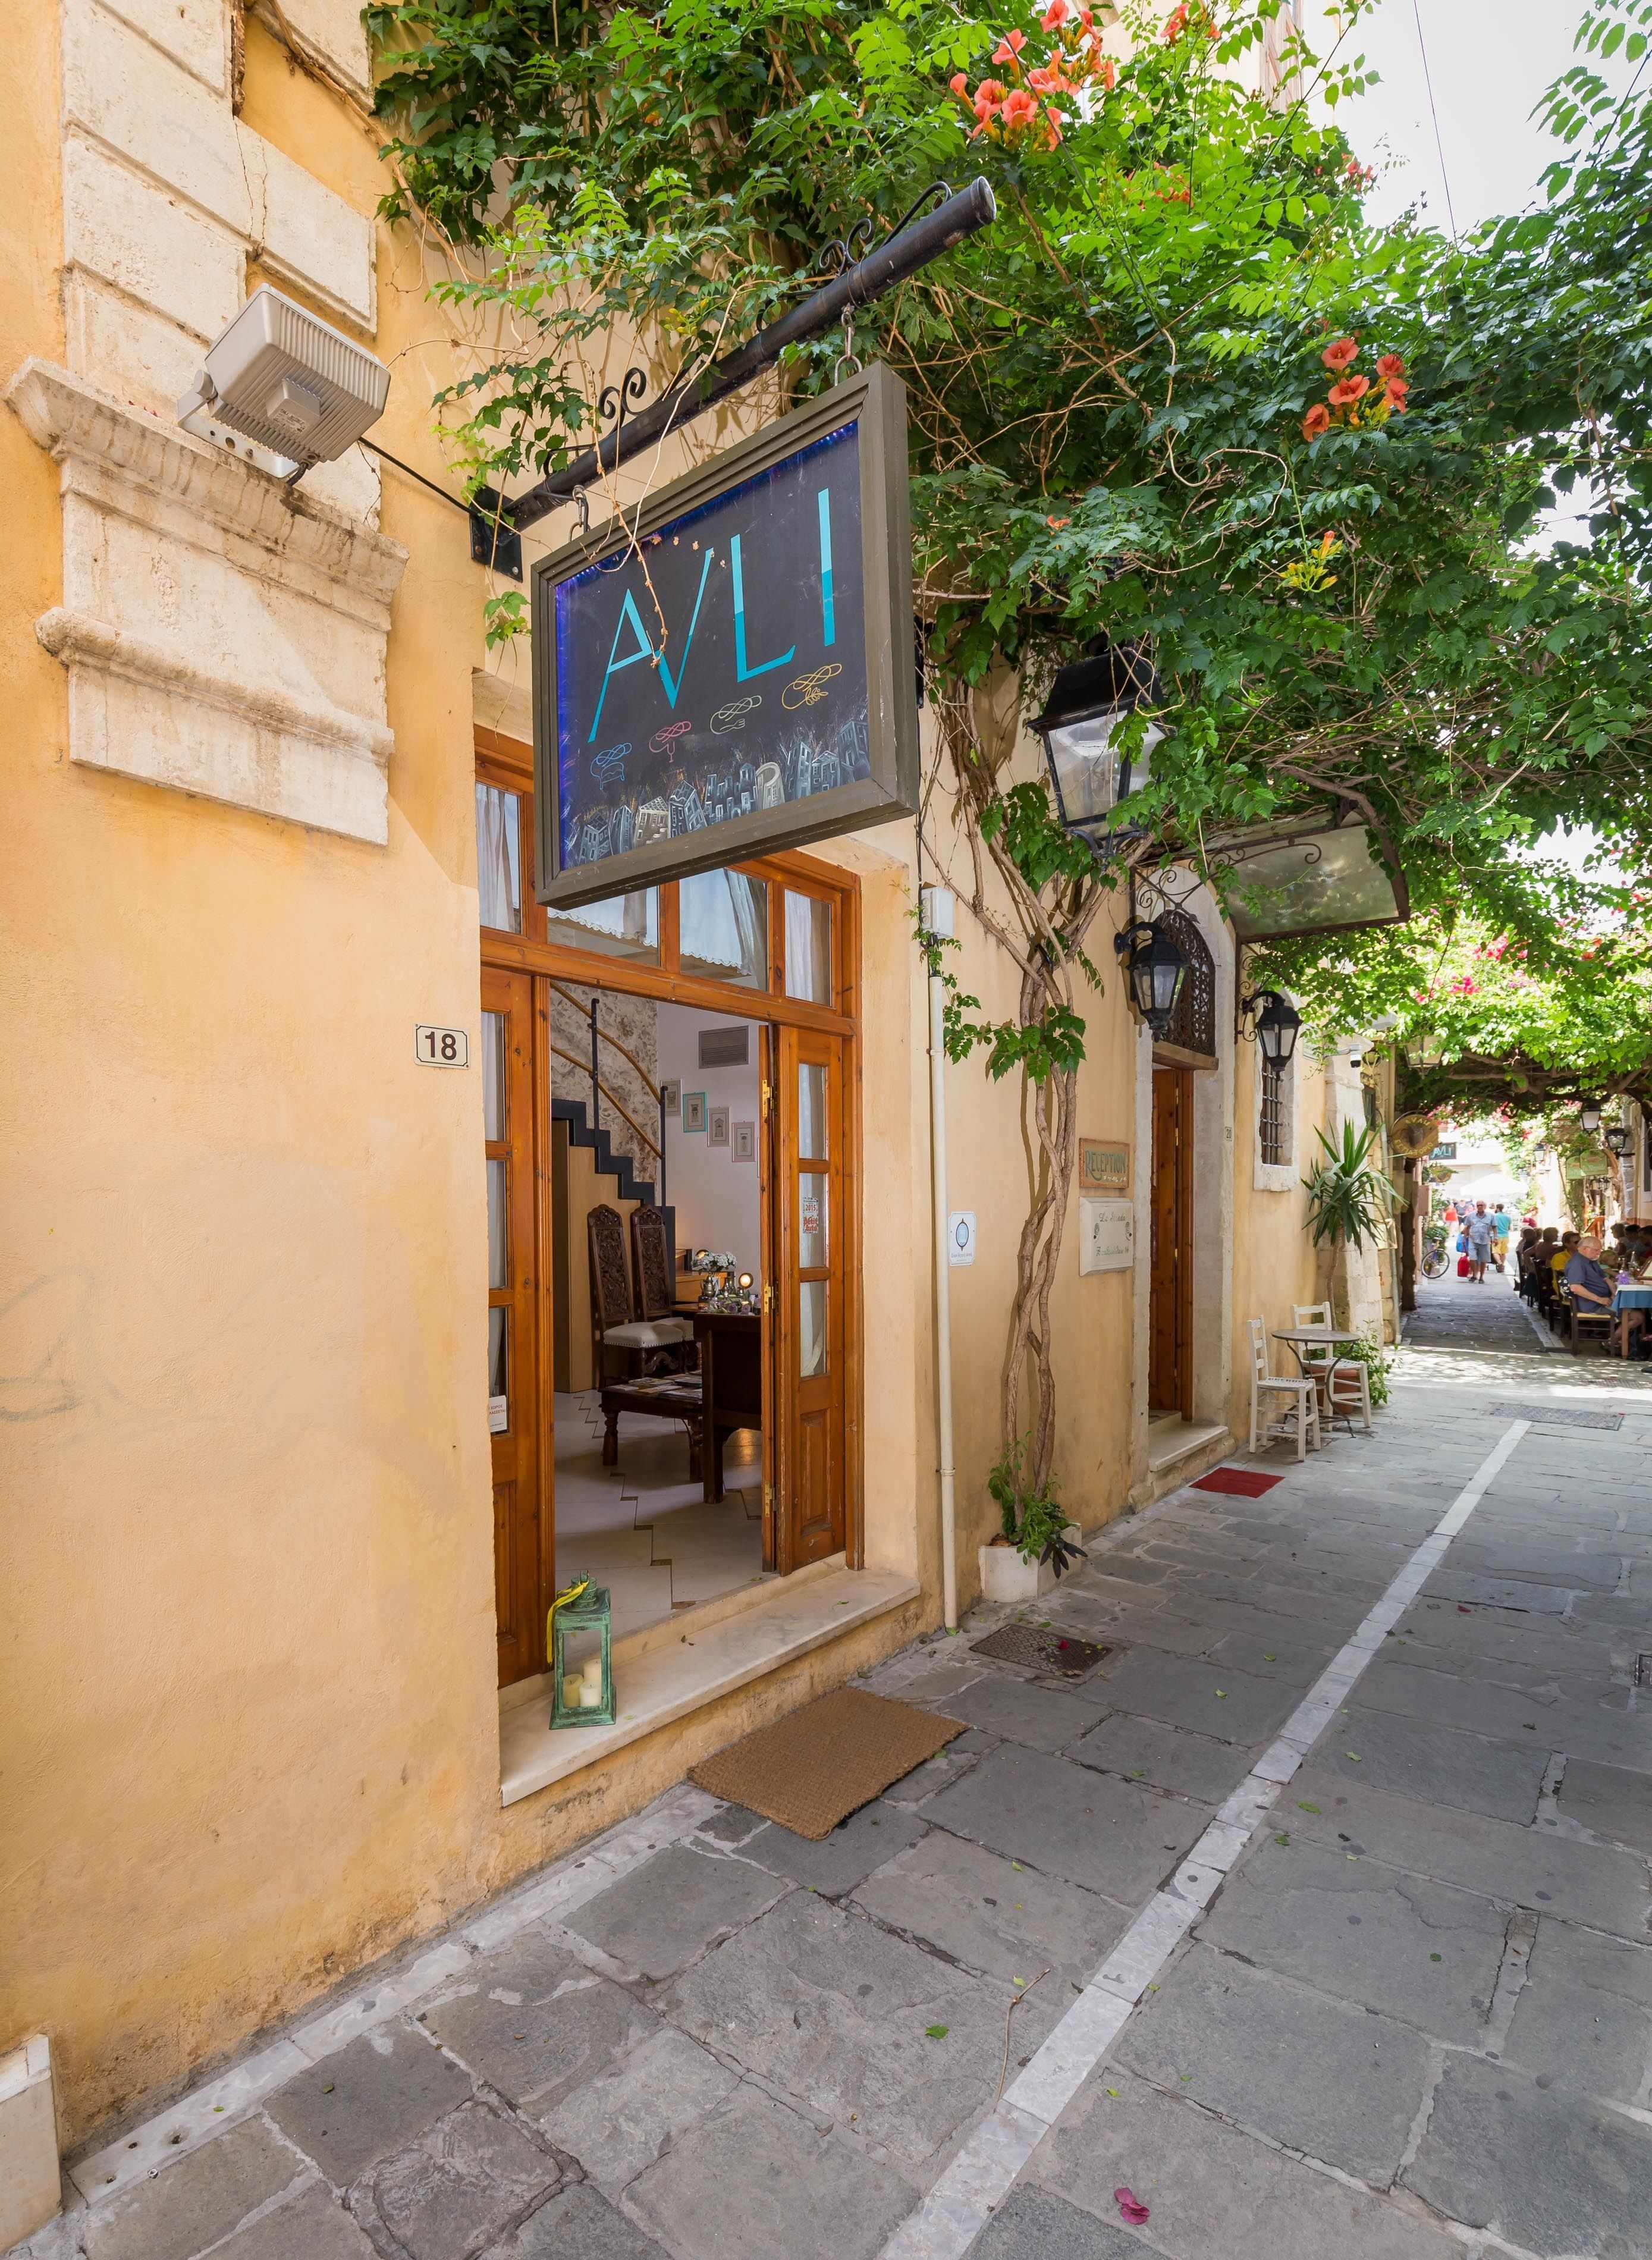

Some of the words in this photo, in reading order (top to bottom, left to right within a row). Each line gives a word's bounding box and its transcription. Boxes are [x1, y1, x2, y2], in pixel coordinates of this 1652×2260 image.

[588, 488, 836, 743] AVLI
[425, 1031, 457, 1060] 18
[1226, 1128, 1232, 1139] 20
[1085, 1149, 1127, 1181] RECEPTION
[1431, 1145, 1452, 1158] AVLI
